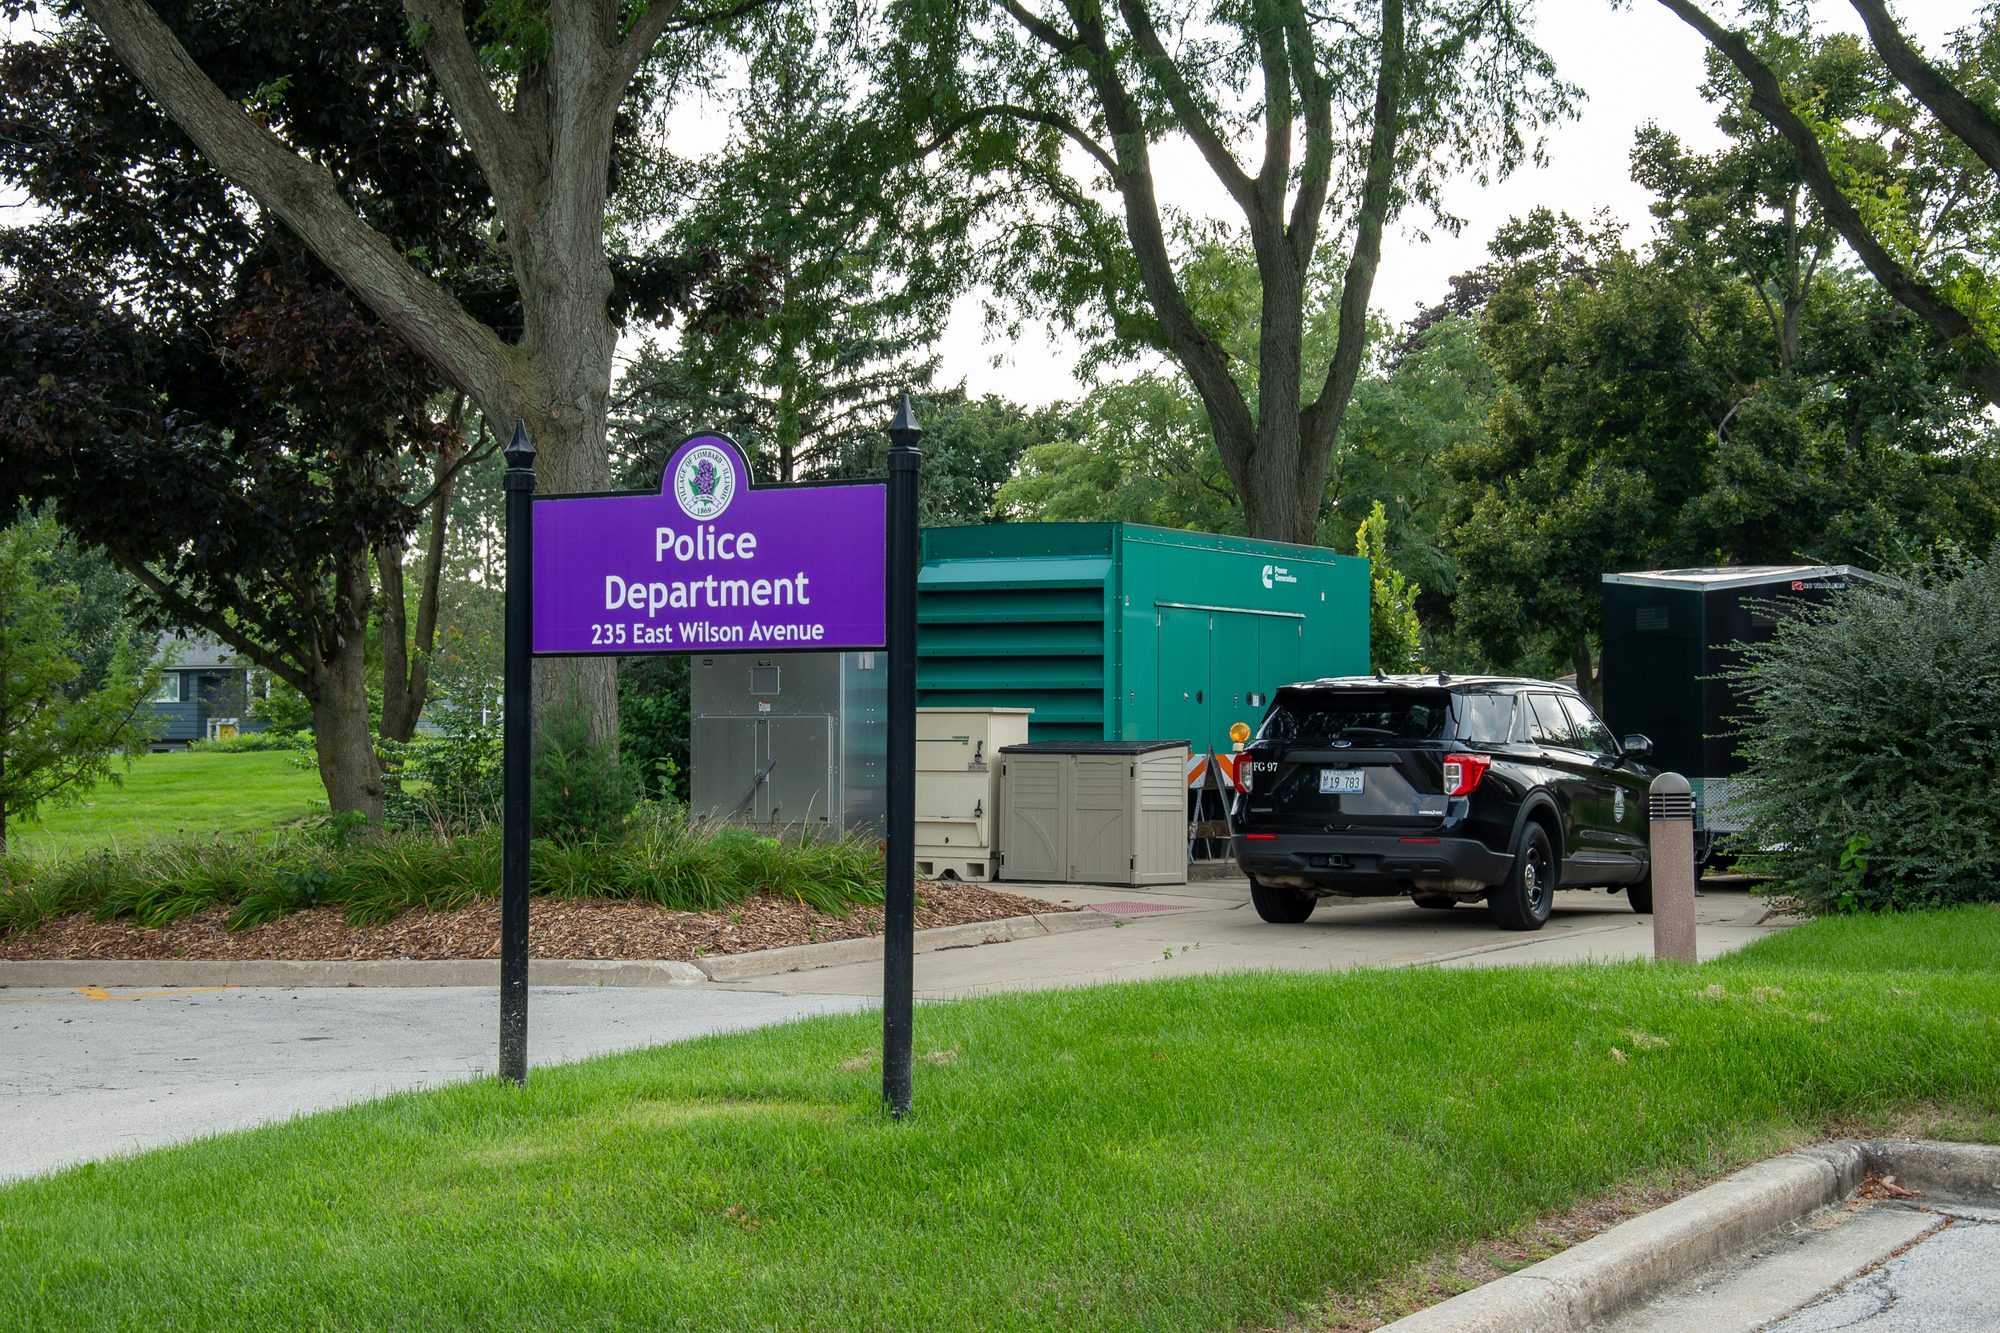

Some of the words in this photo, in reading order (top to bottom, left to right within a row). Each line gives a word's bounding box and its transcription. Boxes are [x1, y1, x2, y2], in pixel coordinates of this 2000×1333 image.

[679, 469, 687, 502] VILLAGE
[685, 459, 692, 467] OF
[694, 451, 722, 464] LOMBARD
[721, 468, 730, 500] ILLINOIS
[656, 525, 757, 562] Police
[605, 571, 810, 617] Department
[591, 623, 626, 645] 235
[633, 622, 673, 644] East
[679, 621, 743, 643] Wilson
[749, 620, 824, 641] Avenue
[1253, 761, 1265, 772] FG
[1267, 761, 1278, 772] 97
[1329, 776, 1340, 789] 19
[1344, 776, 1360, 789] 783
